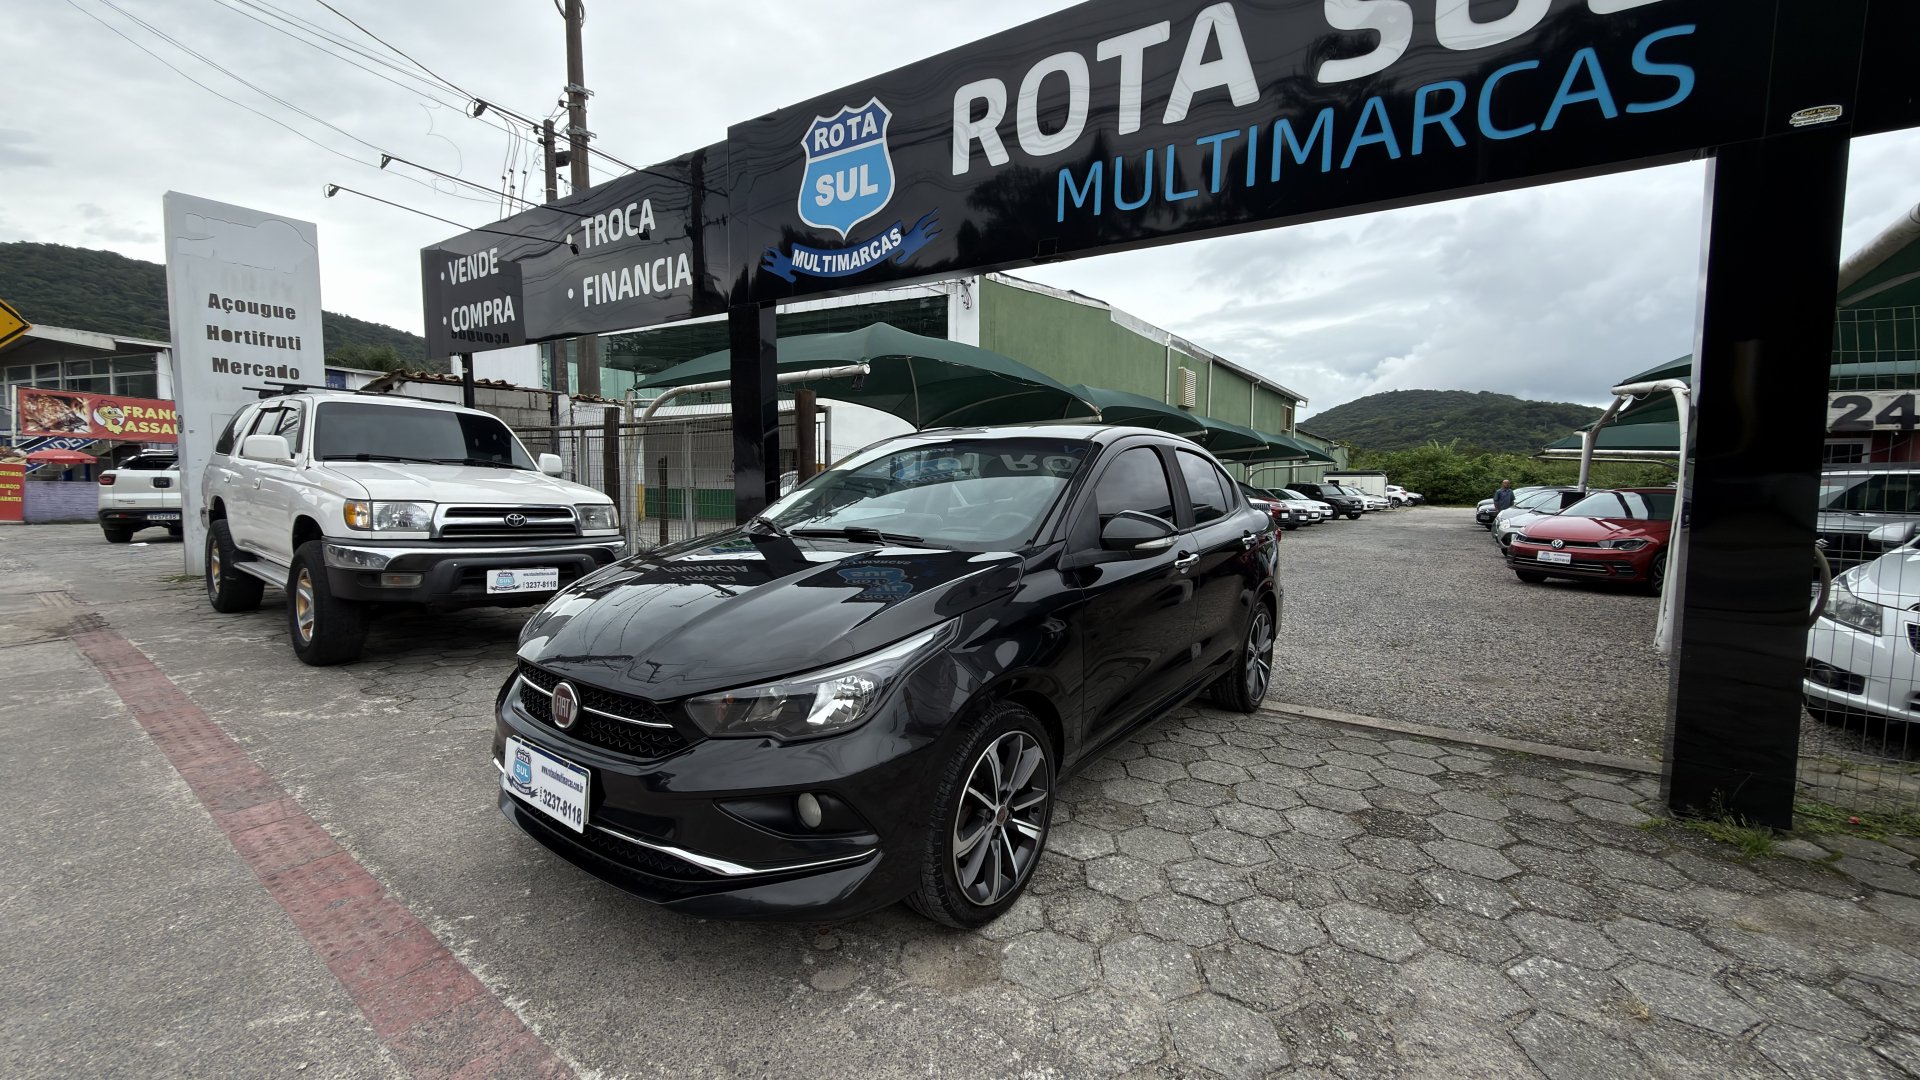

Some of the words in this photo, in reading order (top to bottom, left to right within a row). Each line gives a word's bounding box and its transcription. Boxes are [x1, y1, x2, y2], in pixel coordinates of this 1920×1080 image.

[952, 2, 1260, 176] ROTA
[814, 112, 878, 152] ROTA
[1057, 25, 1696, 222] MULTIMARCAS
[815, 164, 879, 207] SUL
[581, 199, 656, 248] TROCA
[448, 248, 499, 285] VENDE
[792, 227, 902, 273] MULTIMARCAS
[583, 253, 693, 307] FINANCIA
[208, 293, 296, 320] Açougue
[451, 296, 515, 333] COMPRA
[206, 324, 302, 351] Hortifruti
[212, 357, 300, 380] Mercado
[556, 695, 571, 718] FIAT
[516, 763, 528, 778] SUL
[543, 789, 582, 825] 3237-8118
